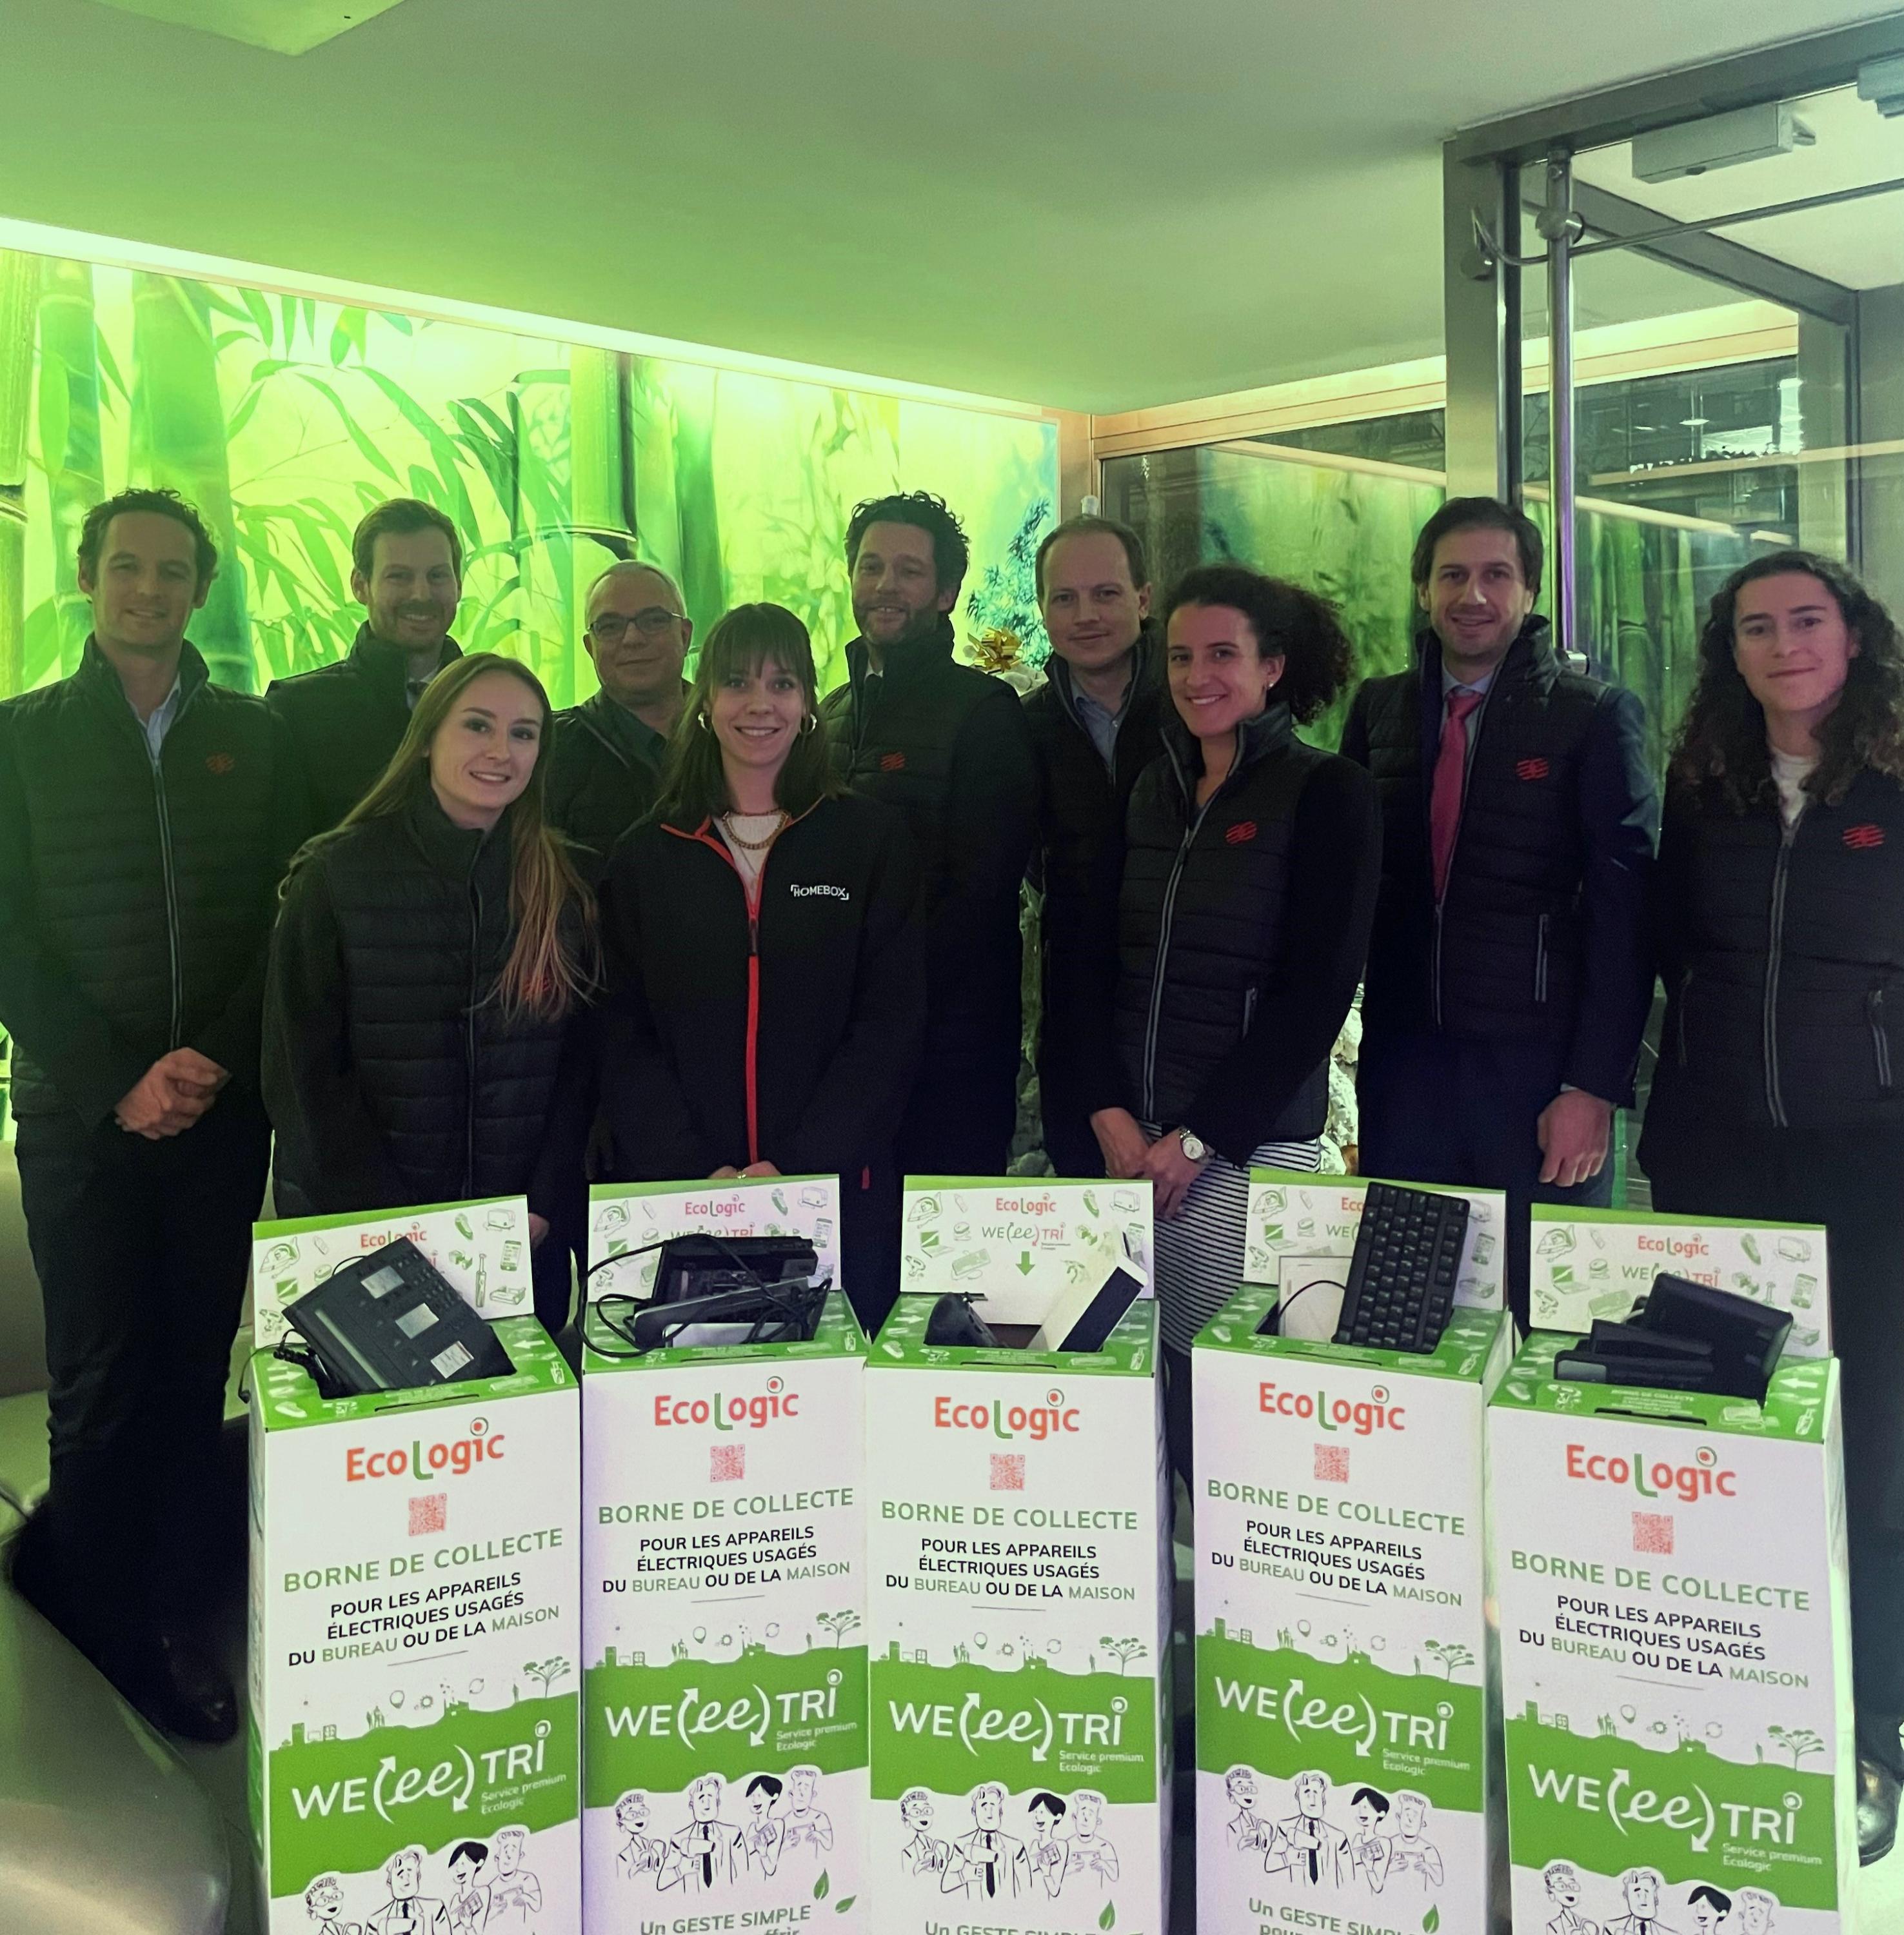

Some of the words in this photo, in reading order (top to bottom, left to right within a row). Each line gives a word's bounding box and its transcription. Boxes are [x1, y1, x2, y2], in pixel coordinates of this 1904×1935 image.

[792, 884, 847, 898] HOMEBOX
[599, 1502, 684, 1525] BORNE
[693, 1499, 725, 1520] DE
[733, 1487, 853, 1516] COLLECTE
[882, 1500, 964, 1524] BORNE
[973, 1507, 1005, 1526] DE
[1013, 1509, 1138, 1530] COLLECTE
[1207, 1478, 1289, 1510] BORNE
[1297, 1494, 1329, 1516] DE
[1338, 1501, 1465, 1536] COLLECTE
[640, 1536, 687, 1553] POUR
[691, 1534, 721, 1549] LES
[725, 1525, 815, 1547] APPAREILS
[921, 1538, 967, 1554] POUR
[972, 1541, 1001, 1556] LES
[1005, 1543, 1097, 1559] APPAREILS
[1246, 1519, 1291, 1541] POUR
[1296, 1528, 1325, 1545] LES
[1329, 1534, 1422, 1560] APPAREILS
[284, 1560, 380, 1593] BORNE
[390, 1553, 425, 1578] DE
[433, 1527, 563, 1569] COLLECTE
[637, 1551, 748, 1573] ÉLECTRIQUES
[752, 1542, 817, 1564] USAGÉS
[918, 1554, 1028, 1578] ÉLECTRIQUES
[1033, 1562, 1100, 1580] USAGÉS
[1244, 1536, 1352, 1570] ÉLECTRIQUES
[1357, 1558, 1425, 1581] USAGÉS
[602, 1579, 627, 1593] DU
[632, 1576, 700, 1593] BUREAU
[705, 1573, 729, 1588] OU
[734, 1571, 757, 1585] DE
[760, 1569, 782, 1583] LA
[787, 1561, 850, 1581] MAISON
[886, 1574, 909, 1589] DU
[914, 1578, 980, 1594] BUREAU
[985, 1582, 1009, 1596] OU
[1015, 1583, 1037, 1597] DE
[1042, 1584, 1064, 1598] LA
[1068, 1585, 1135, 1600] MAISON
[1211, 1551, 1234, 1568] DU
[1239, 1558, 1305, 1582] BUREAU
[1309, 1571, 1334, 1587] OU
[1338, 1574, 1361, 1592] DE
[1365, 1579, 1388, 1596] LA
[1393, 1584, 1462, 1607] MAISON
[1511, 1550, 1605, 1585] BORNE
[1614, 1567, 1652, 1592] DE
[1662, 1574, 1810, 1612] COLLECTE
[330, 1597, 383, 1619] POUR
[388, 1591, 421, 1609] LES
[425, 1571, 521, 1603] APPAREILS
[327, 1606, 450, 1640] ÉLECTRIQUES
[455, 1589, 524, 1618] USAGÉS
[1557, 1594, 1610, 1618] POUR
[1615, 1604, 1649, 1623] LES
[1653, 1611, 1761, 1638] APPAREILS
[288, 1649, 315, 1667] DU
[322, 1637, 398, 1662] BUREAU
[402, 1631, 430, 1649] OU
[435, 1625, 459, 1643] DE
[464, 1621, 487, 1638] LA
[491, 1605, 559, 1632] MAISON
[1555, 1612, 1681, 1650] ÉLECTRIQUES
[1687, 1637, 1766, 1661] USAGÉS
[1519, 1628, 1545, 1647] DU
[1551, 1636, 1627, 1663] BUREAU
[1632, 1651, 1660, 1669] OU
[1666, 1656, 1692, 1674] DE
[1698, 1660, 1723, 1678] LA
[1729, 1666, 1809, 1688] MAISON
[776, 1727, 812, 1741] Service
[814, 1721, 857, 1737] premium
[776, 1739, 817, 1752] Ecologic
[1058, 1761, 1102, 1775] Ecologic
[1059, 1750, 1096, 1761] Service
[1099, 1751, 1144, 1764] premium
[1383, 1748, 1421, 1763] Service
[1423, 1754, 1471, 1771] premium
[1383, 1760, 1426, 1776] Ecologic
[481, 1784, 519, 1803] Service
[522, 1773, 567, 1794] premium
[481, 1798, 524, 1815] Ecologic
[1722, 1843, 1766, 1858] Service
[1769, 1849, 1822, 1865] premium
[1723, 1856, 1772, 1872] Ecologic
[640, 1920, 666, 1935] Un
[672, 1914, 735, 1934] GESTE
[740, 1905, 811, 1927] SIMPLE
[1249, 1897, 1273, 1918] Un
[1280, 1906, 1342, 1933] GESTE
